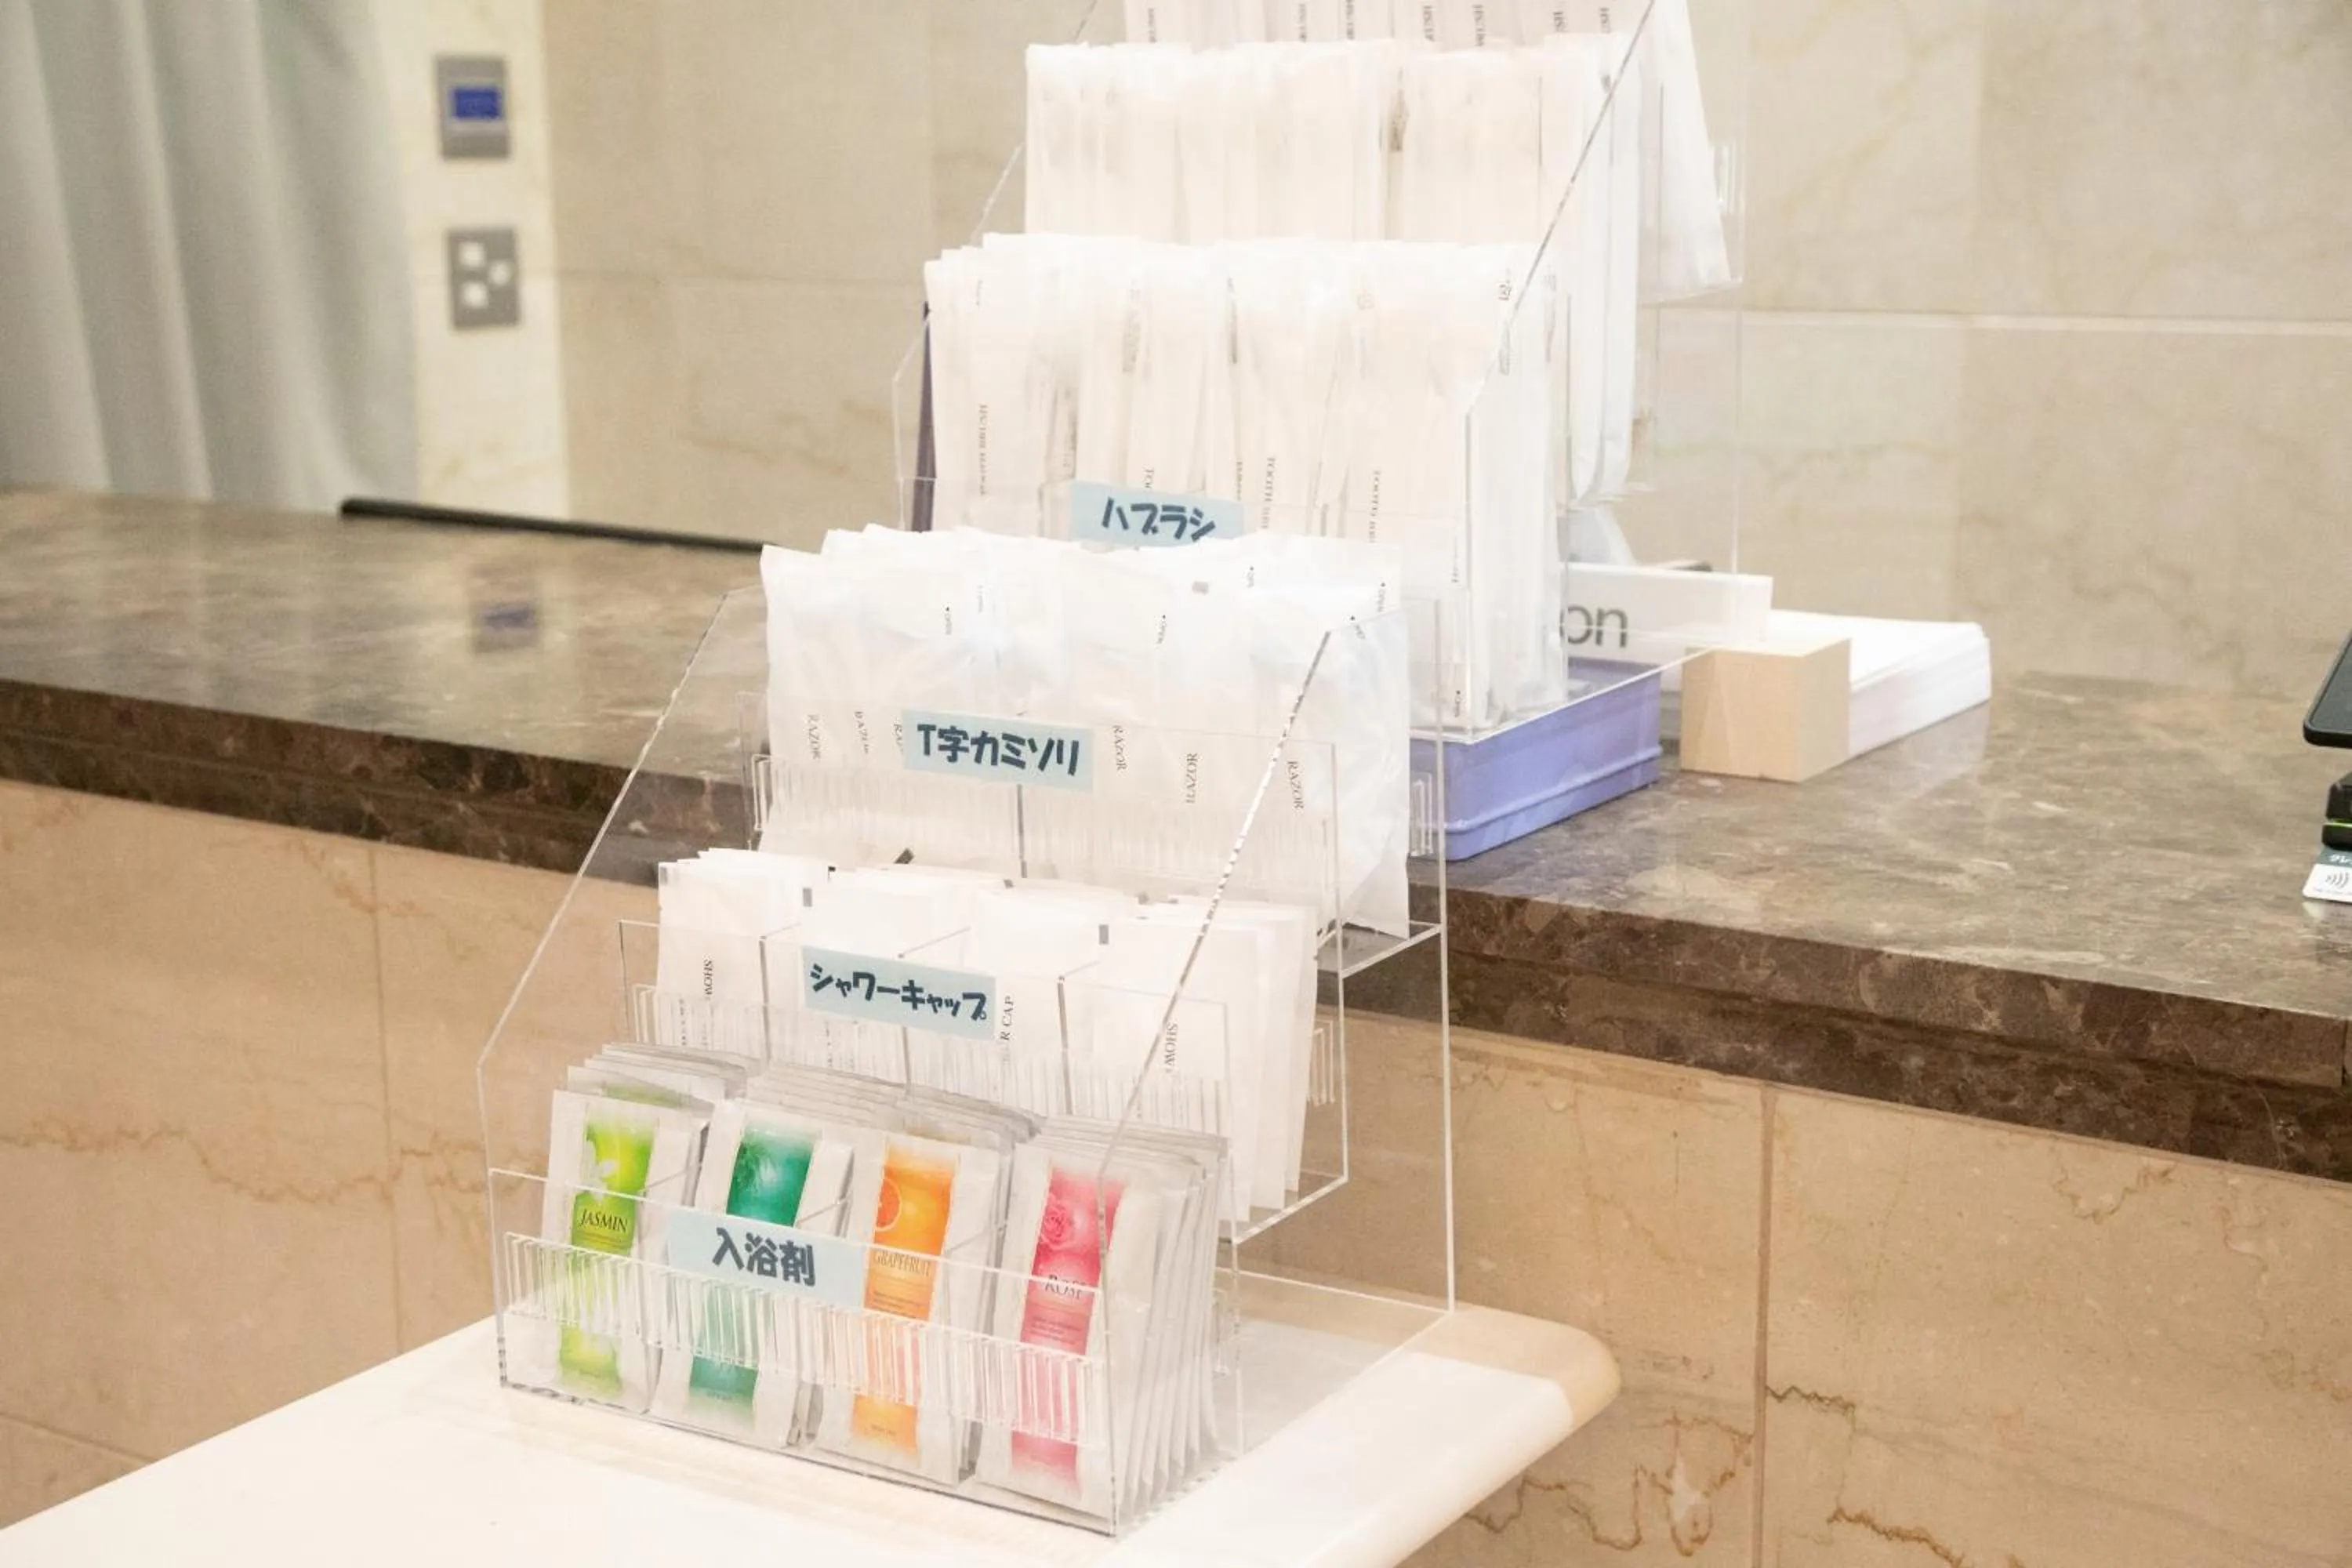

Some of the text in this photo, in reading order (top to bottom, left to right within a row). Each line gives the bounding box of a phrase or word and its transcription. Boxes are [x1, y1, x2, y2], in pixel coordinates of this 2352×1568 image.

[1102, 496, 1217, 543] ハブラシ
[917, 724, 1080, 776] T字カミソリ
[1112, 724, 1127, 771] RAZOR
[1185, 752, 1199, 804] RAZOR
[1286, 760, 1305, 810] RAZOR
[810, 964, 987, 1021] シャワーキャップ
[579, 1208, 628, 1233] JASMIN
[712, 1227, 816, 1287] 入浴剤
[873, 1250, 931, 1277] GRAPEFRUIT
